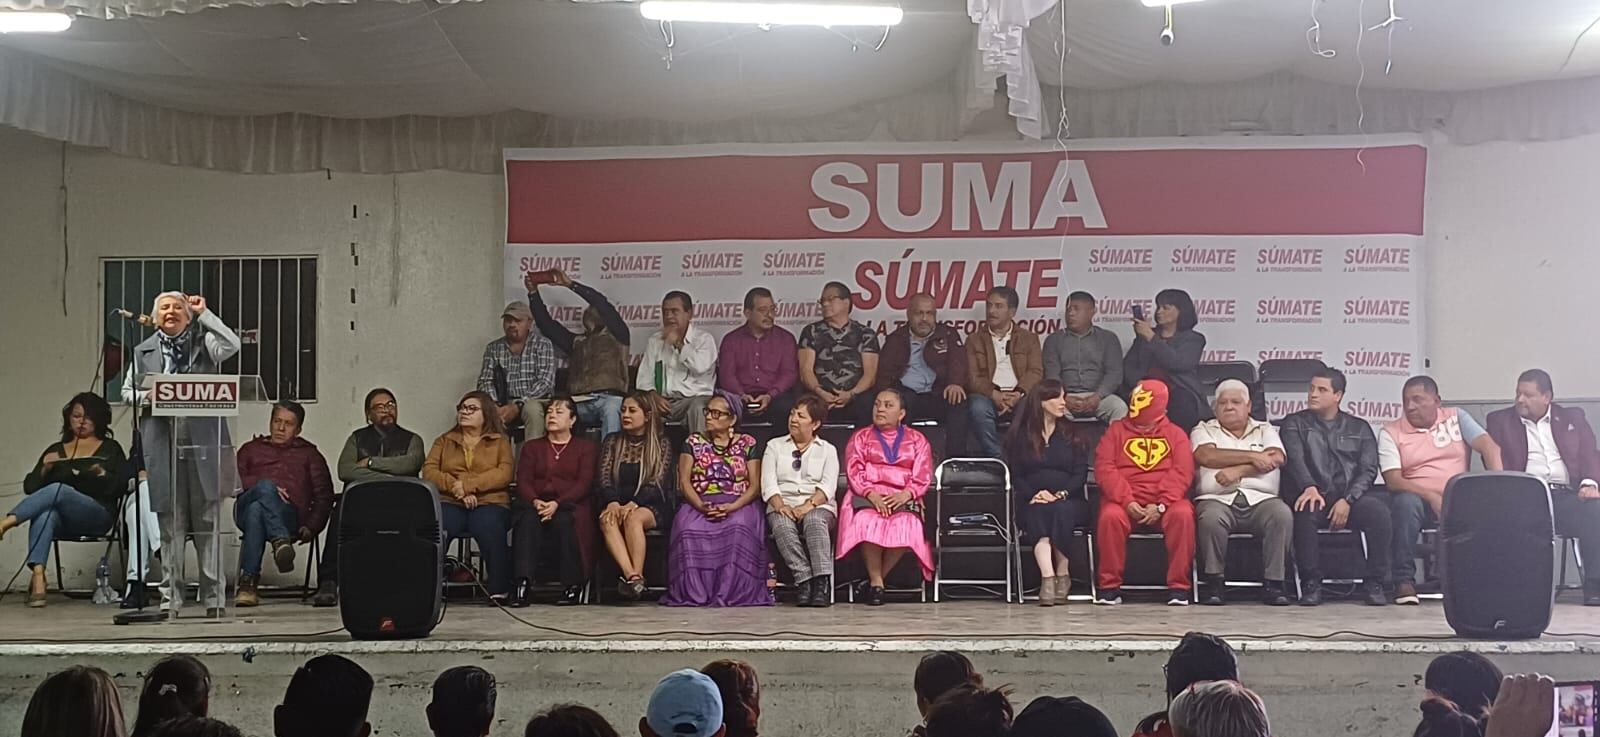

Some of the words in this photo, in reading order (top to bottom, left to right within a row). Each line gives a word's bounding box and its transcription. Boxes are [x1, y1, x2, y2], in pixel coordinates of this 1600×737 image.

[807, 160, 1108, 233] SUMA
[519, 253, 581, 272] SÚMATE
[600, 252, 662, 271] SÚMATE
[681, 250, 743, 269] SÚMATE
[763, 249, 825, 268] SÚMATE
[1089, 245, 1153, 264] SÚMATE
[1171, 245, 1236, 264] SÚMATE
[1257, 245, 1323, 264] SÚMATE
[1344, 245, 1410, 264] SÚMATE
[852, 248, 1062, 310] SÚMATE
[692, 300, 742, 318] ÚMATE
[774, 299, 822, 317] ÚMATE
[1193, 300, 1236, 315] MATE
[1257, 296, 1322, 315] SÚMATE
[1344, 296, 1410, 316] SÚMATE
[1344, 348, 1411, 368] SÚMATE
[158, 383, 233, 400] SUMA
[1265, 397, 1307, 415] ÚMA
[1345, 398, 1401, 418] SÚMAT
